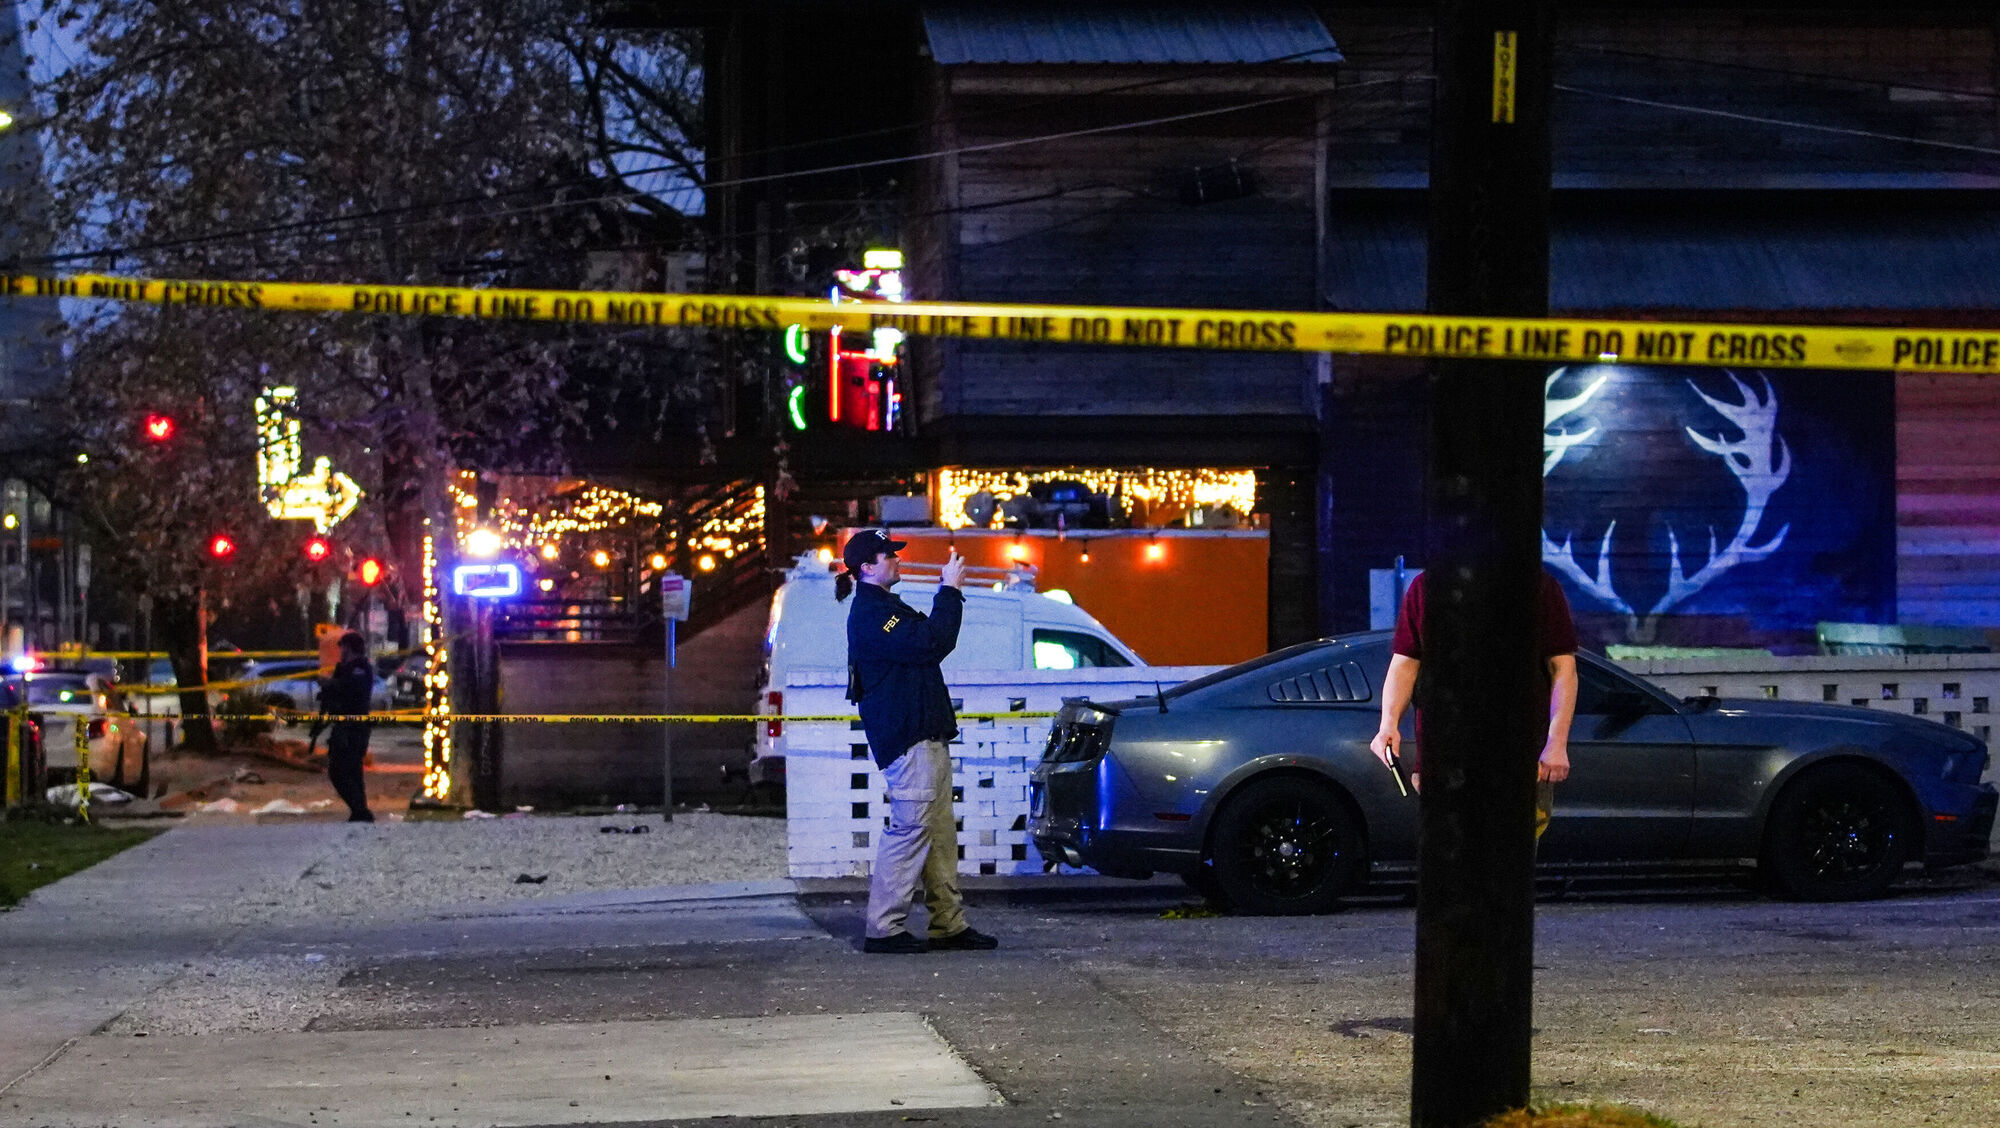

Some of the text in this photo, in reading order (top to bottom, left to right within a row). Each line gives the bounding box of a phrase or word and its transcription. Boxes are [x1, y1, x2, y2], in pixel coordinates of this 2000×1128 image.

[353, 290, 461, 315] POLICE
[474, 295, 541, 318] LINE
[553, 297, 595, 321] DO
[607, 299, 665, 324] NOT
[680, 302, 781, 328] CROSS
[1071, 317, 1112, 342] DO
[1125, 318, 1184, 344] NOT
[1196, 319, 1297, 346] CROSS
[1385, 324, 1493, 352] POLICE
[1504, 327, 1571, 353] LINE
[1584, 329, 1623, 356] DO
[1635, 331, 1696, 359] NOT
[1708, 333, 1807, 362] CROSS
[1893, 336, 2000, 367] POLICE
[882, 614, 900, 633] FBI
